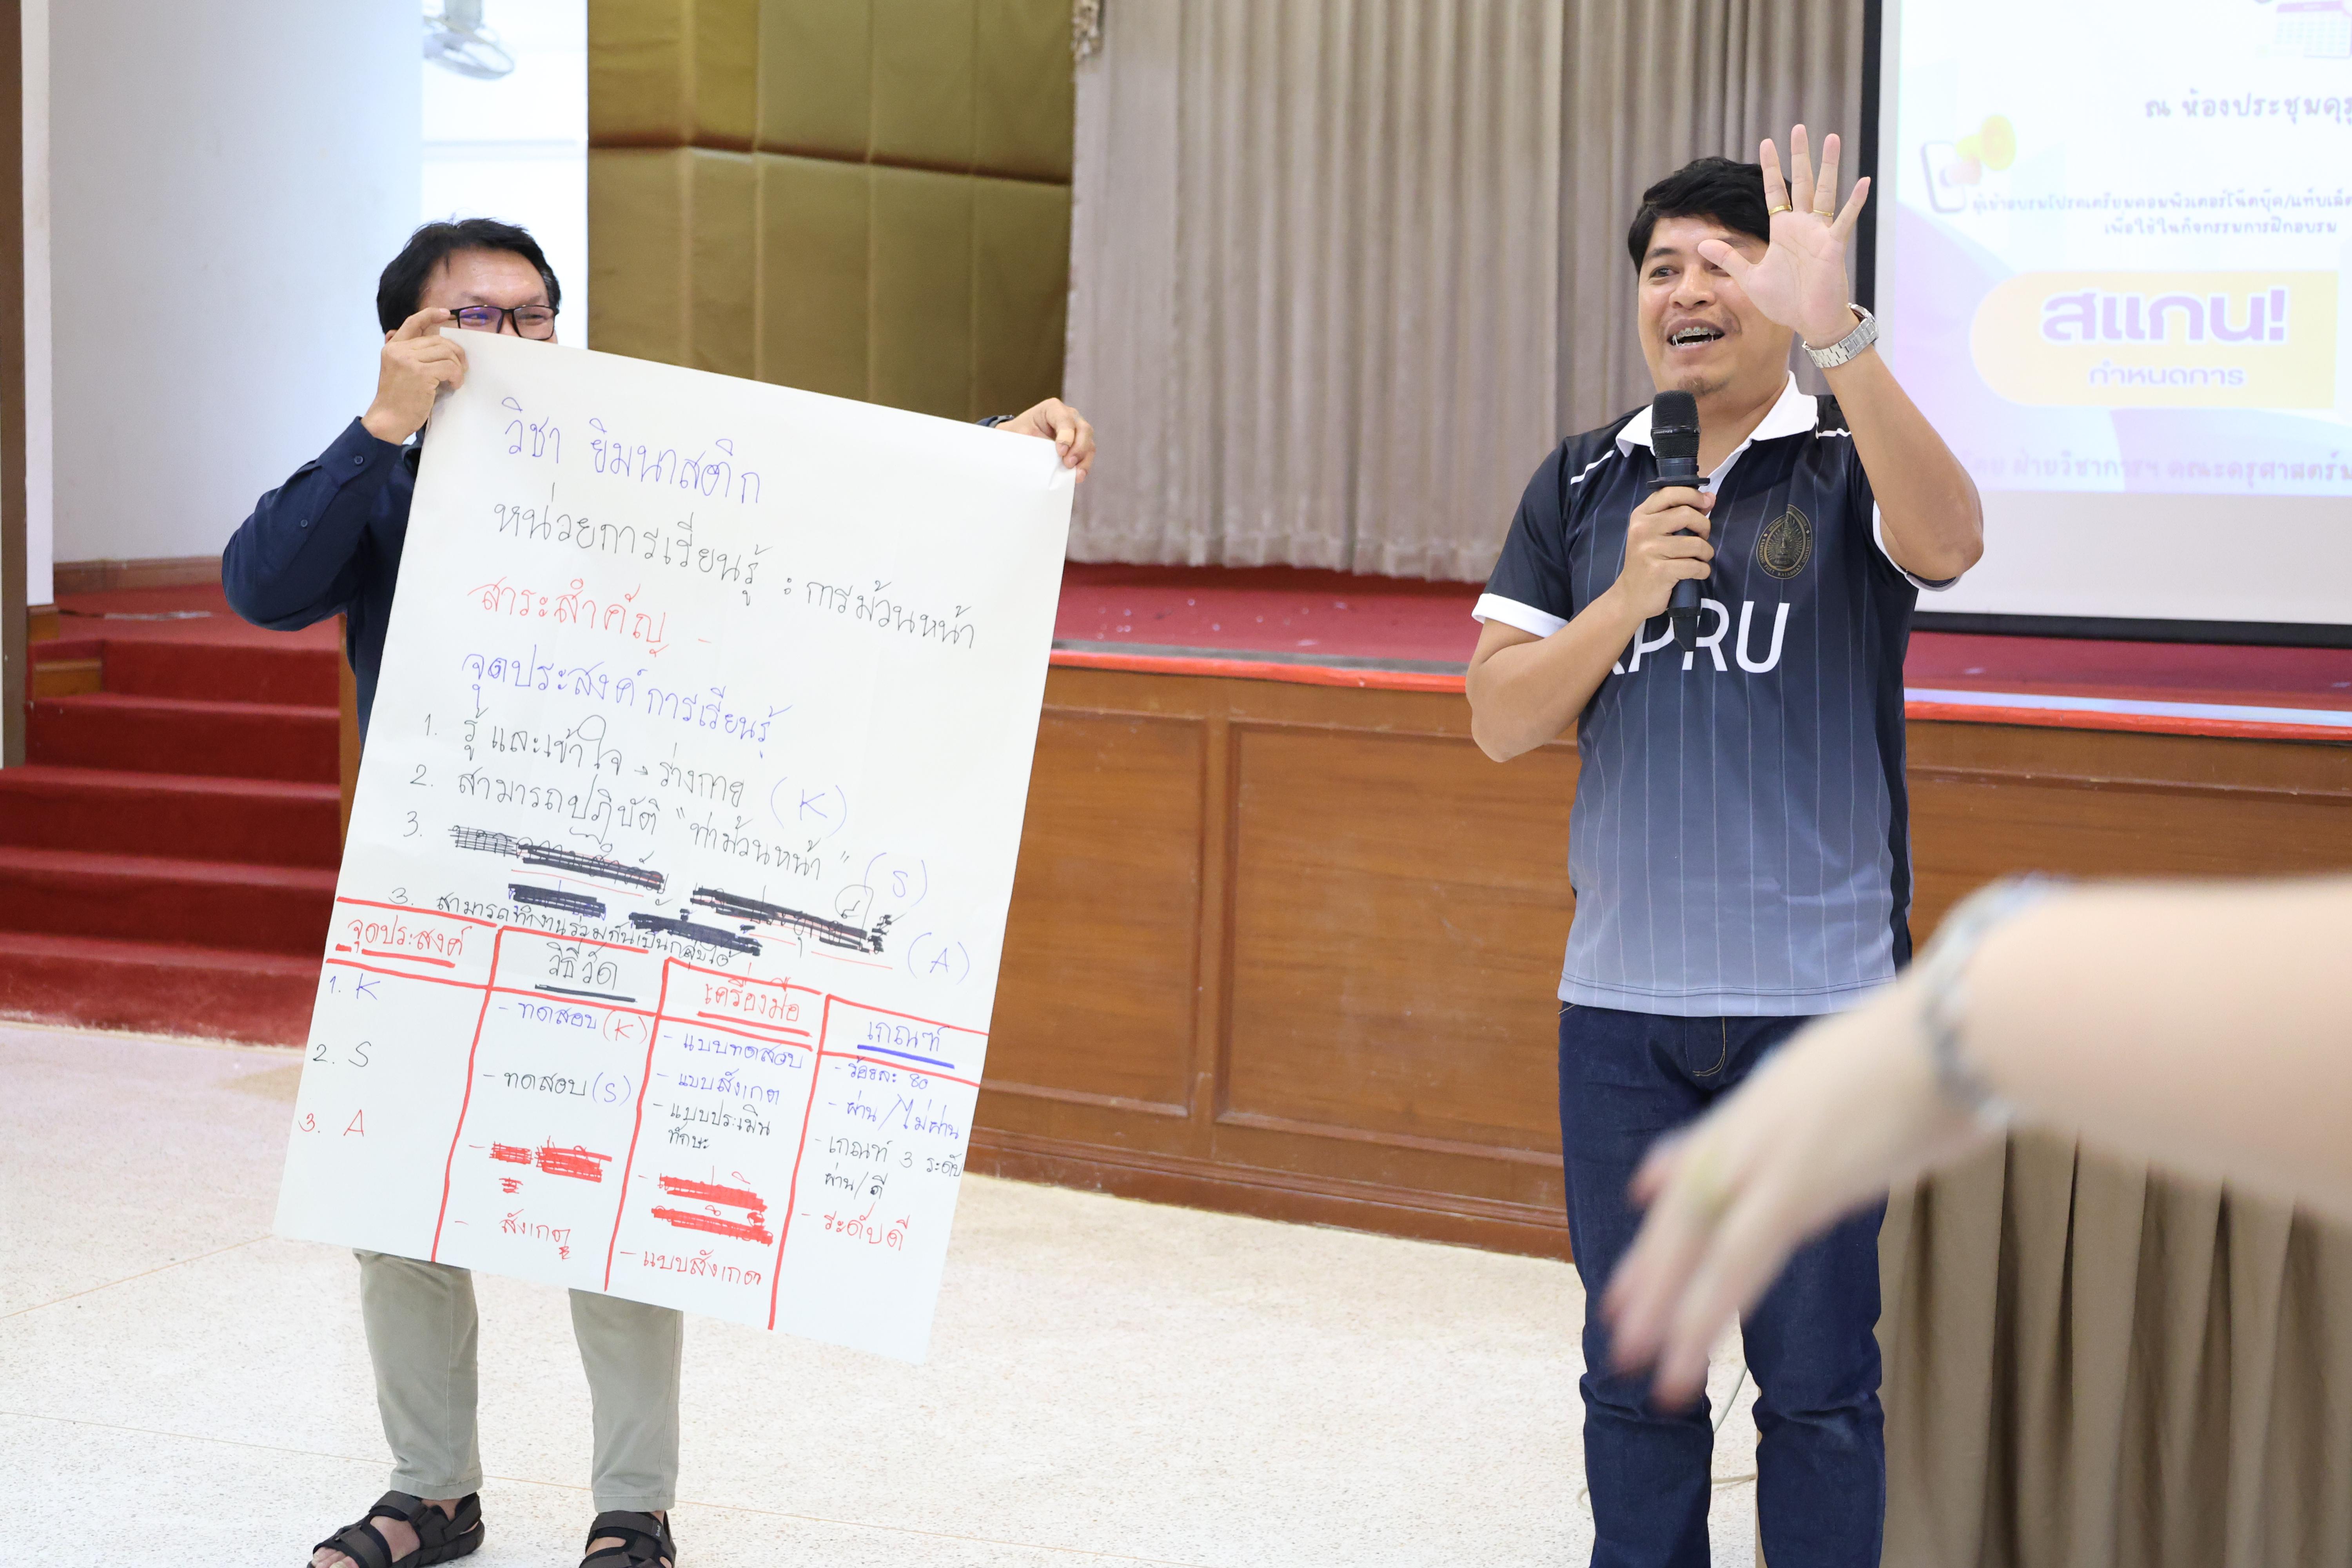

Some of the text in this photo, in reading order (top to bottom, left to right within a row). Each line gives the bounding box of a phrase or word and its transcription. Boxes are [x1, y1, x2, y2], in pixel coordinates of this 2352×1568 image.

[2042, 288, 2287, 343] สแกน!
[2089, 360, 2245, 387] กำหนดการ
[502, 397, 760, 504] วิชา ยิมนาสติก
[494, 483, 770, 606] หน่วยการเรียนรู้
[806, 580, 975, 649] การม้วนหน้า
[467, 577, 669, 657] สาระสำคัญ
[1613, 598, 1790, 675] PRU
[660, 742, 744, 807] ร่างกาย
[771, 776, 847, 838] (K)
[410, 764, 433, 787] 2.
[864, 852, 927, 908] (S)
[348, 915, 473, 956] จุดประสงค์
[908, 931, 970, 985] (A)
[356, 973, 381, 1000] K
[705, 962, 799, 1022] เครื่องมือ
[313, 1041, 372, 1067] 2. S
[683, 1033, 804, 1069] แบบทดสอบ
[678, 1068, 780, 1105] แบบสังเกต
[298, 1109, 364, 1137] 3. A
[668, 1121, 710, 1149] ทักษะ
[670, 1099, 771, 1136] แบบประเมิน
[899, 1151, 913, 1168] 3
[926, 1153, 964, 1177] ระดับ
[643, 1249, 762, 1286] แบบสังเกต
